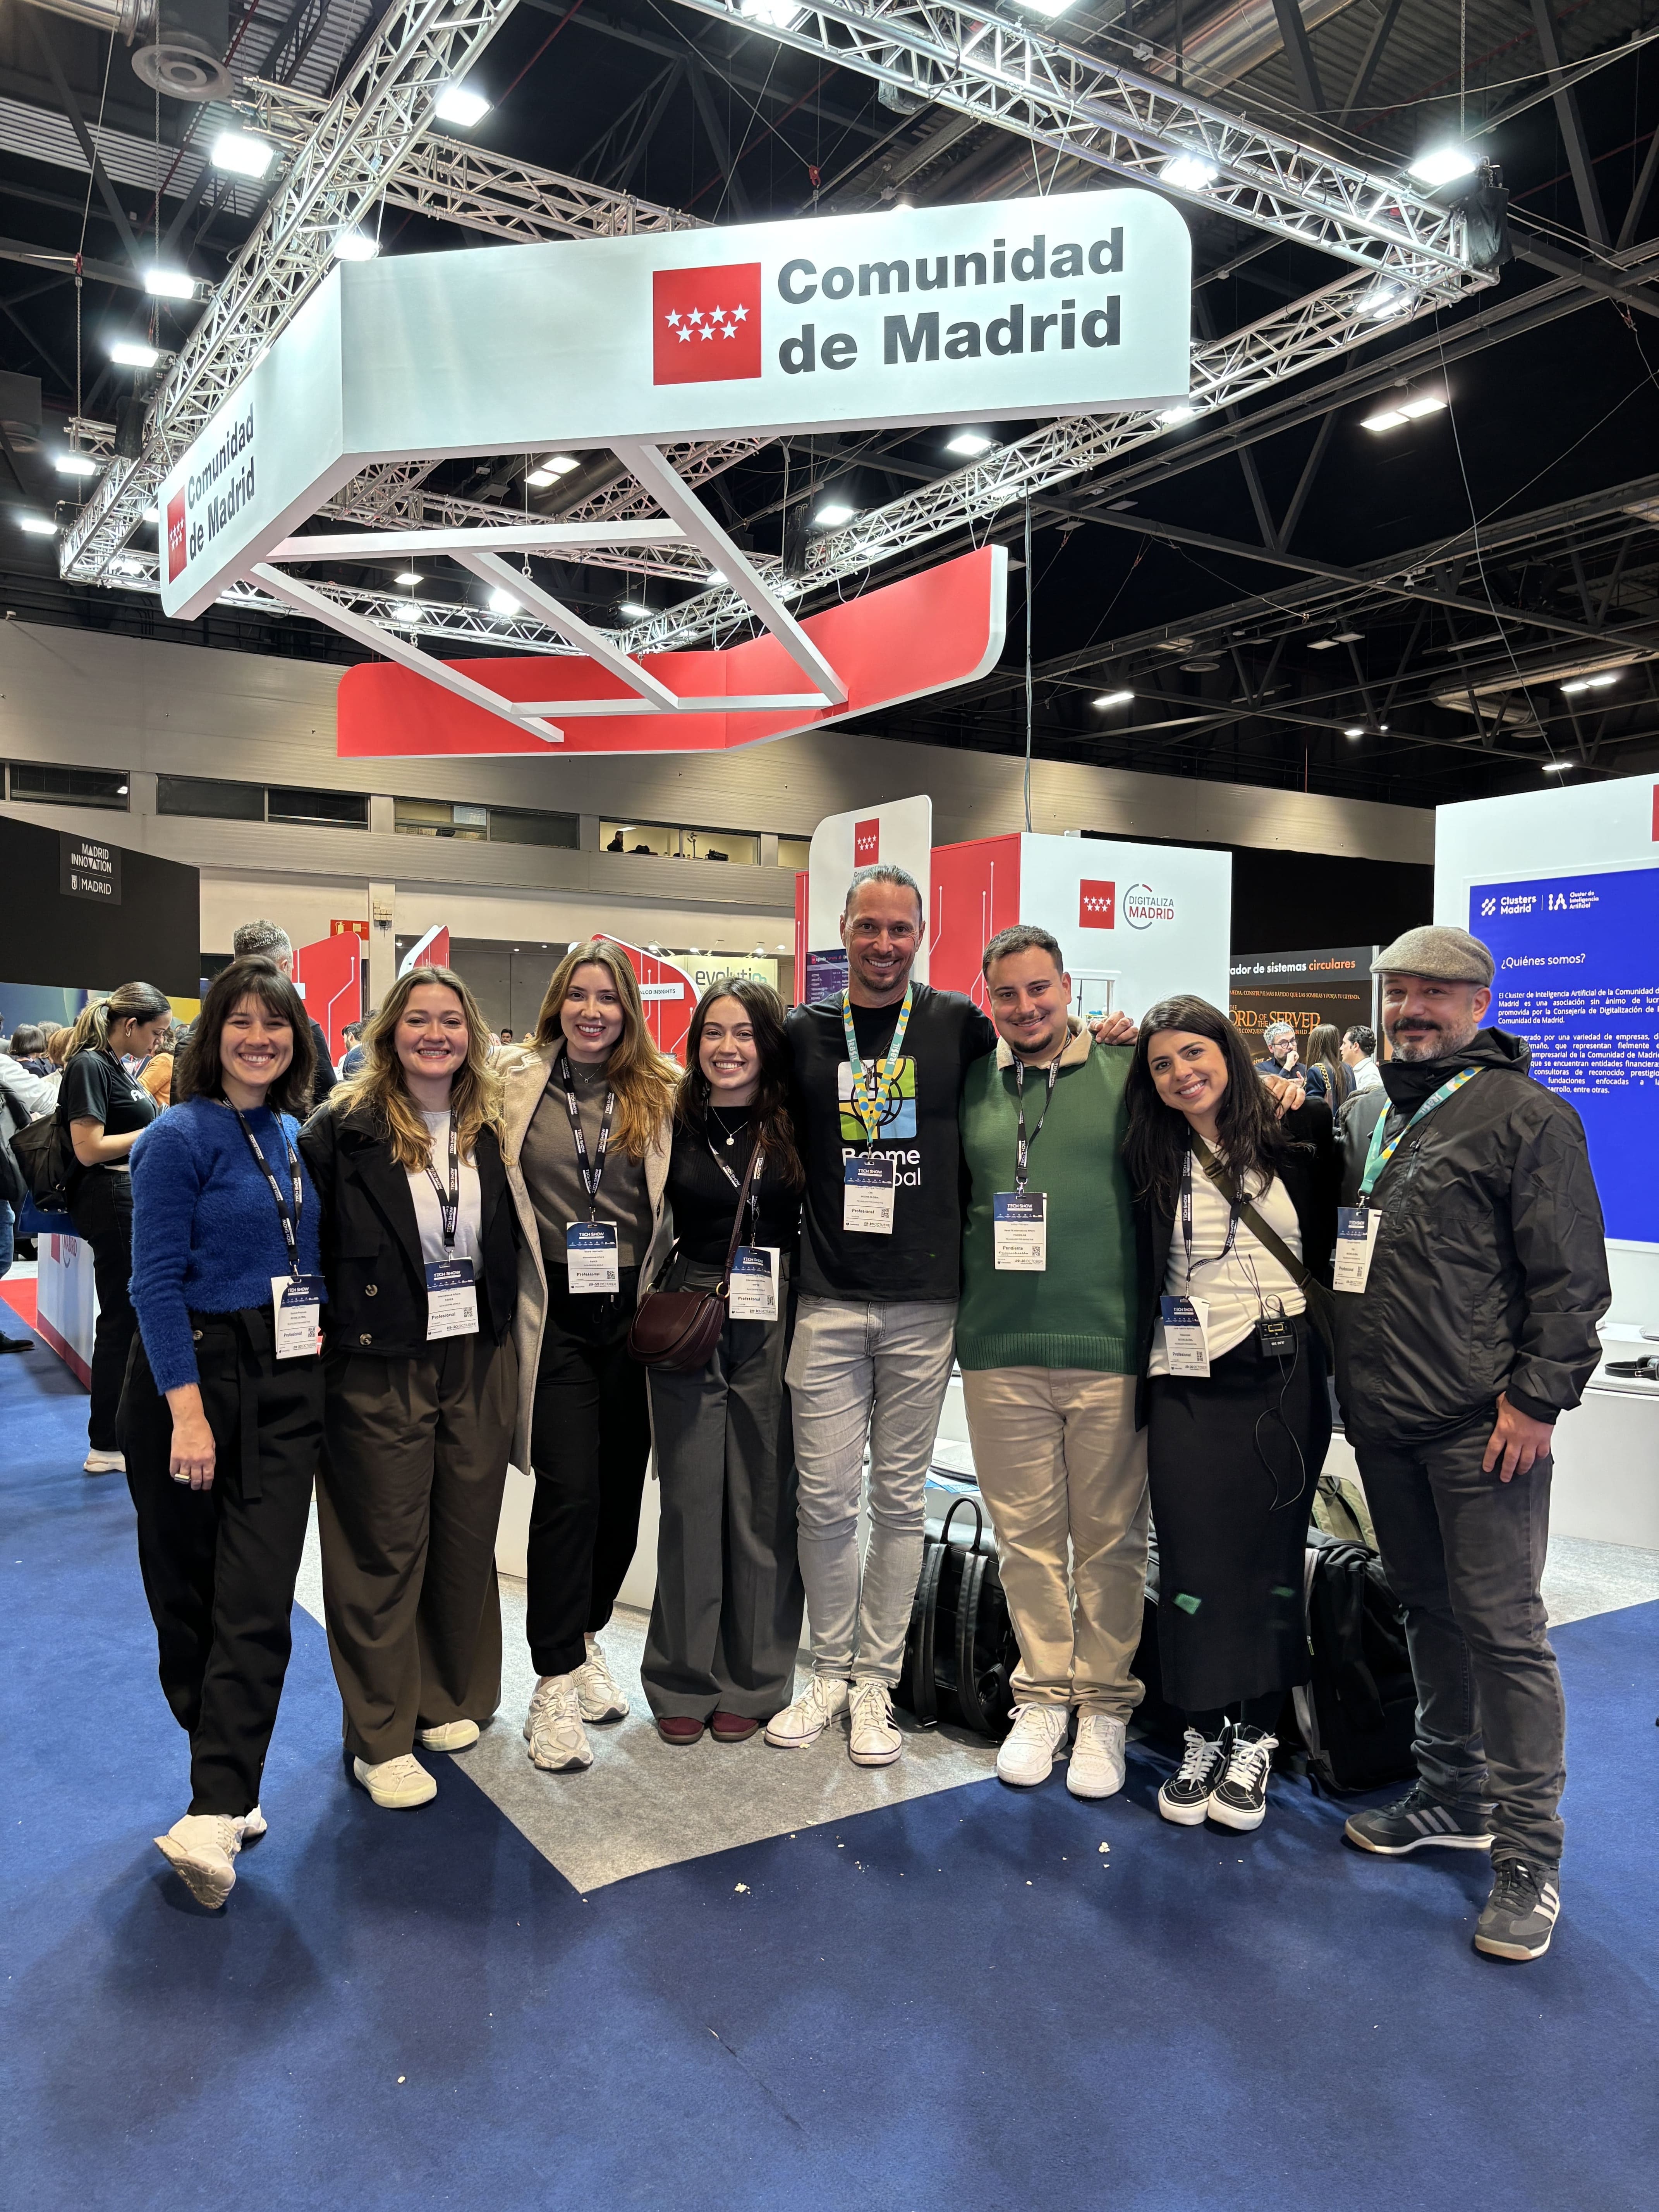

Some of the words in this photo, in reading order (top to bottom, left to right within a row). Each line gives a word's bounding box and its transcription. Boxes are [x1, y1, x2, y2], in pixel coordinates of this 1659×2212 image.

[778, 227, 1123, 304] Comunidad
[779, 323, 858, 375] de
[884, 295, 1120, 365] Madrid
[188, 402, 253, 510] Comunidad
[190, 521, 204, 561] de
[208, 455, 254, 542] Madrid
[82, 843, 109, 860] MADRID
[71, 853, 112, 873] INNOVATION
[81, 878, 112, 895] MADRID
[1129, 896, 1174, 907] DIGITALIZA
[1501, 895, 1537, 905] Clusters
[1501, 903, 1531, 914] Madrid
[1129, 906, 1174, 920] MADRID
[1229, 963, 1251, 975] ador
[1253, 963, 1264, 974] de
[1267, 962, 1307, 973] sistemas
[1309, 958, 1355, 970] circulares
[1501, 956, 1545, 969] ¿Quiénes
[1547, 953, 1585, 965] somos?
[1535, 990, 1569, 999] Inteligencia
[1498, 1009, 1529, 1017] promovida
[1553, 1007, 1586, 1016] Consejería
[1600, 1006, 1642, 1015] Digitalización
